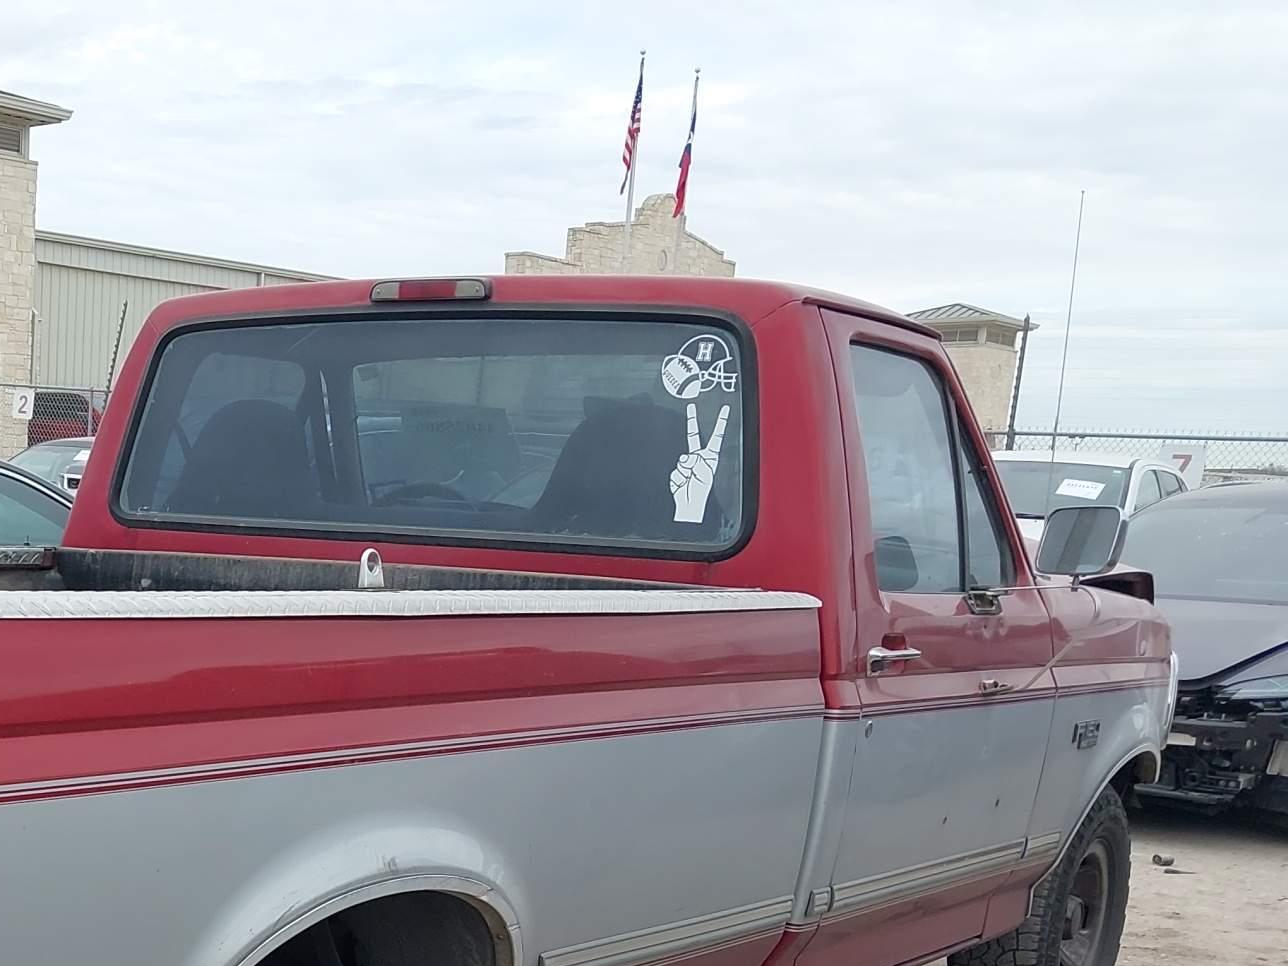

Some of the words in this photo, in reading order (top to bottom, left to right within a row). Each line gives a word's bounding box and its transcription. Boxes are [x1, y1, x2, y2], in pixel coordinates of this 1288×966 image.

[696, 341, 715, 361] H
[17, 394, 29, 415] 2
[1172, 454, 1193, 473] 7
